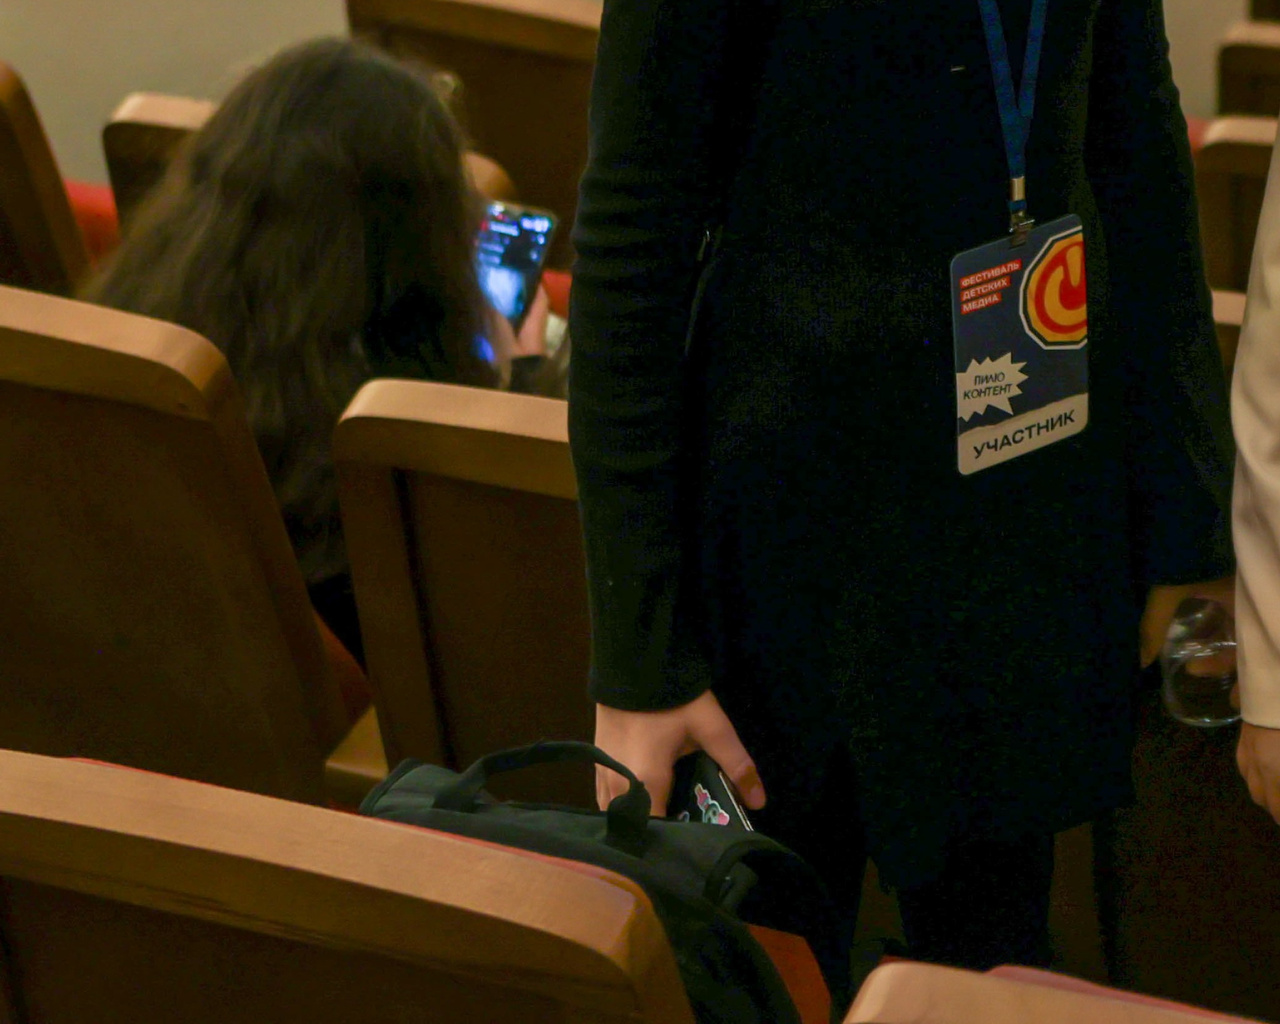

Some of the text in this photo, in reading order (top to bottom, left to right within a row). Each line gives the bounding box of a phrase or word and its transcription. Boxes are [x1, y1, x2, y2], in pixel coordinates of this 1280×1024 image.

[961, 262, 1020, 287] ФЕСТИВАЛЬ
[963, 279, 1007, 301] ДЕТСКИХ
[962, 294, 999, 313] МЕДИА
[974, 372, 1006, 386] ПИЛЮ
[963, 383, 1013, 400] КОНТЕНТ
[973, 409, 1075, 458] УЧАСТНИК
